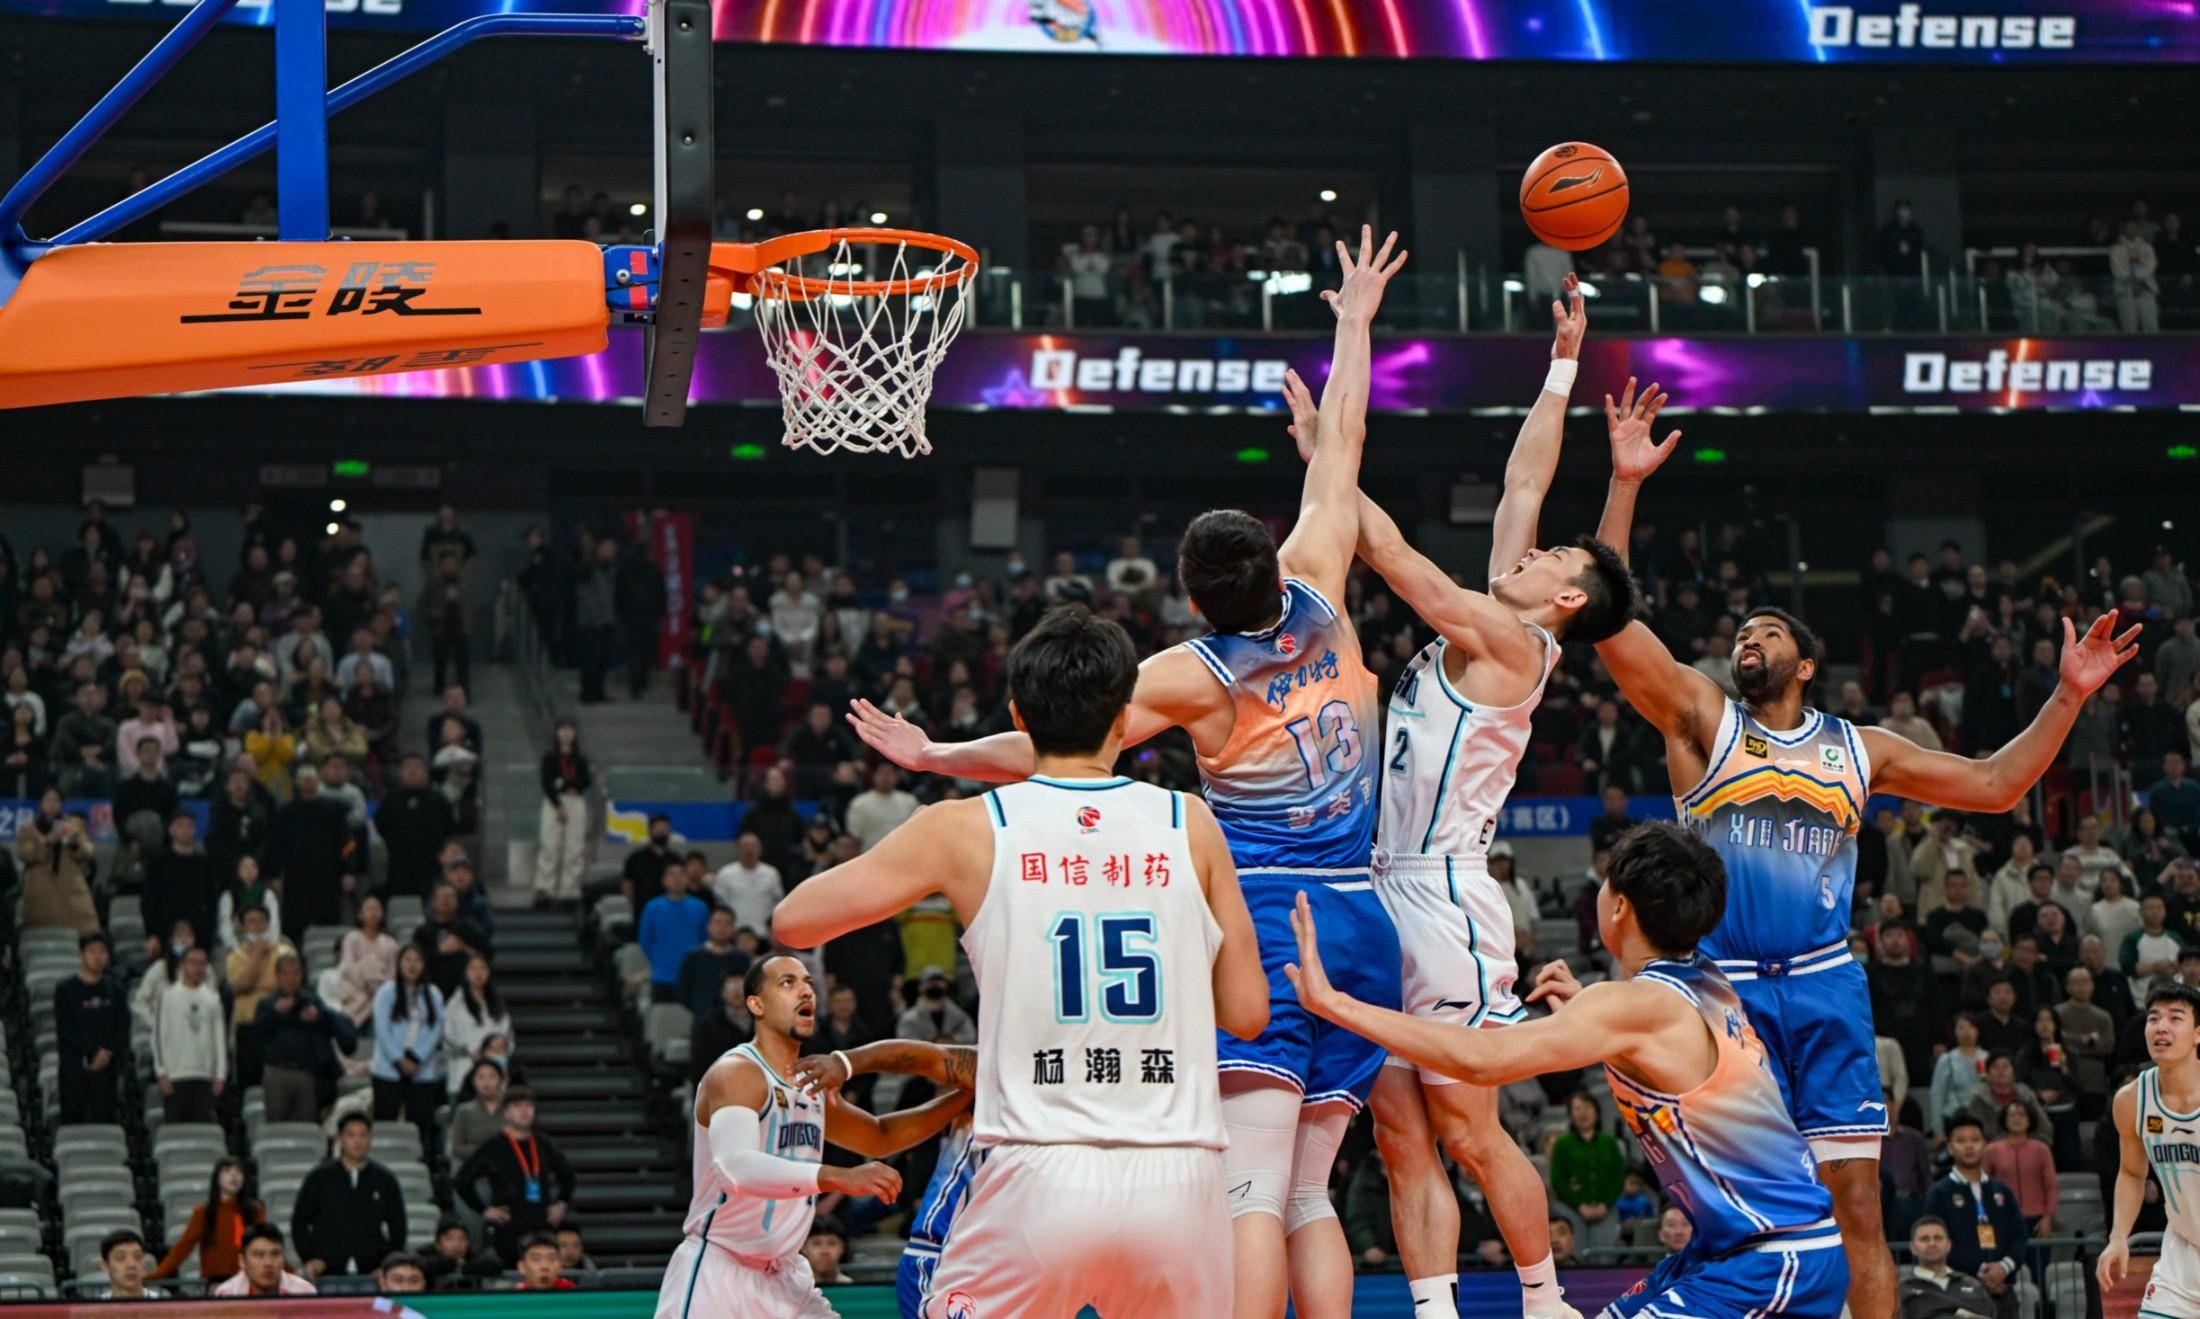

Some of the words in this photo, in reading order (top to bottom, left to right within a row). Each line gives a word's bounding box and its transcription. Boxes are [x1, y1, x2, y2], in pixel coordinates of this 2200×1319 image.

[1809, 4, 2075, 47] Defense
[181, 262, 482, 323] 金陵
[1031, 347, 1287, 391] Defense
[1904, 350, 2152, 391] Defense
[1285, 700, 1363, 790] 13
[1729, 813, 1773, 849] XIN
[1021, 853, 1170, 887] 国信制药
[1820, 875, 1836, 909] 5
[1046, 910, 1164, 1023] 15
[1033, 1048, 1174, 1084] 杨瀚森
[2153, 1143, 2200, 1164] QINGD
